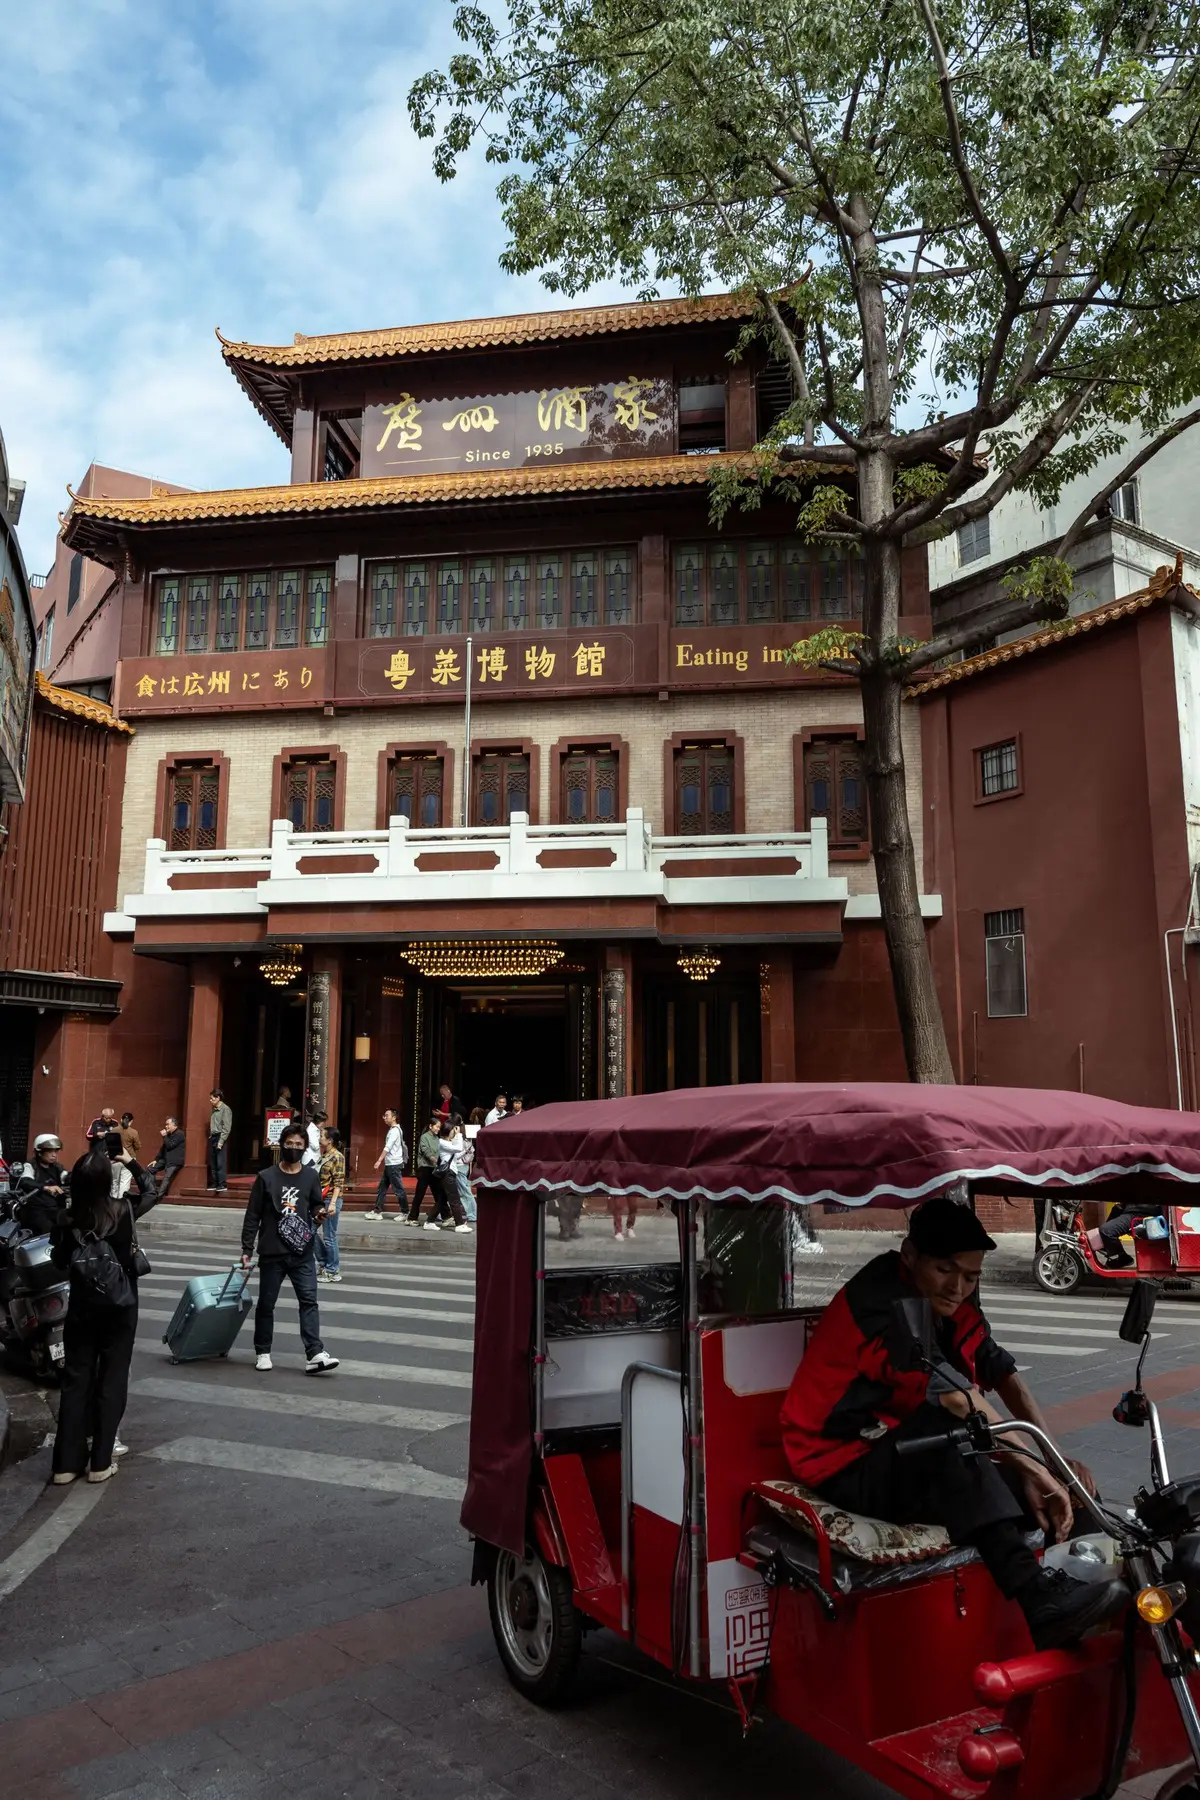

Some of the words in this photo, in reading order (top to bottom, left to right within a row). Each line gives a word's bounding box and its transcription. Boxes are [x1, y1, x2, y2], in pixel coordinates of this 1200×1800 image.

[465, 449, 511, 463] Since
[524, 442, 564, 457] 1935
[675, 644, 749, 671] Eating
[763, 645, 783, 663] in
